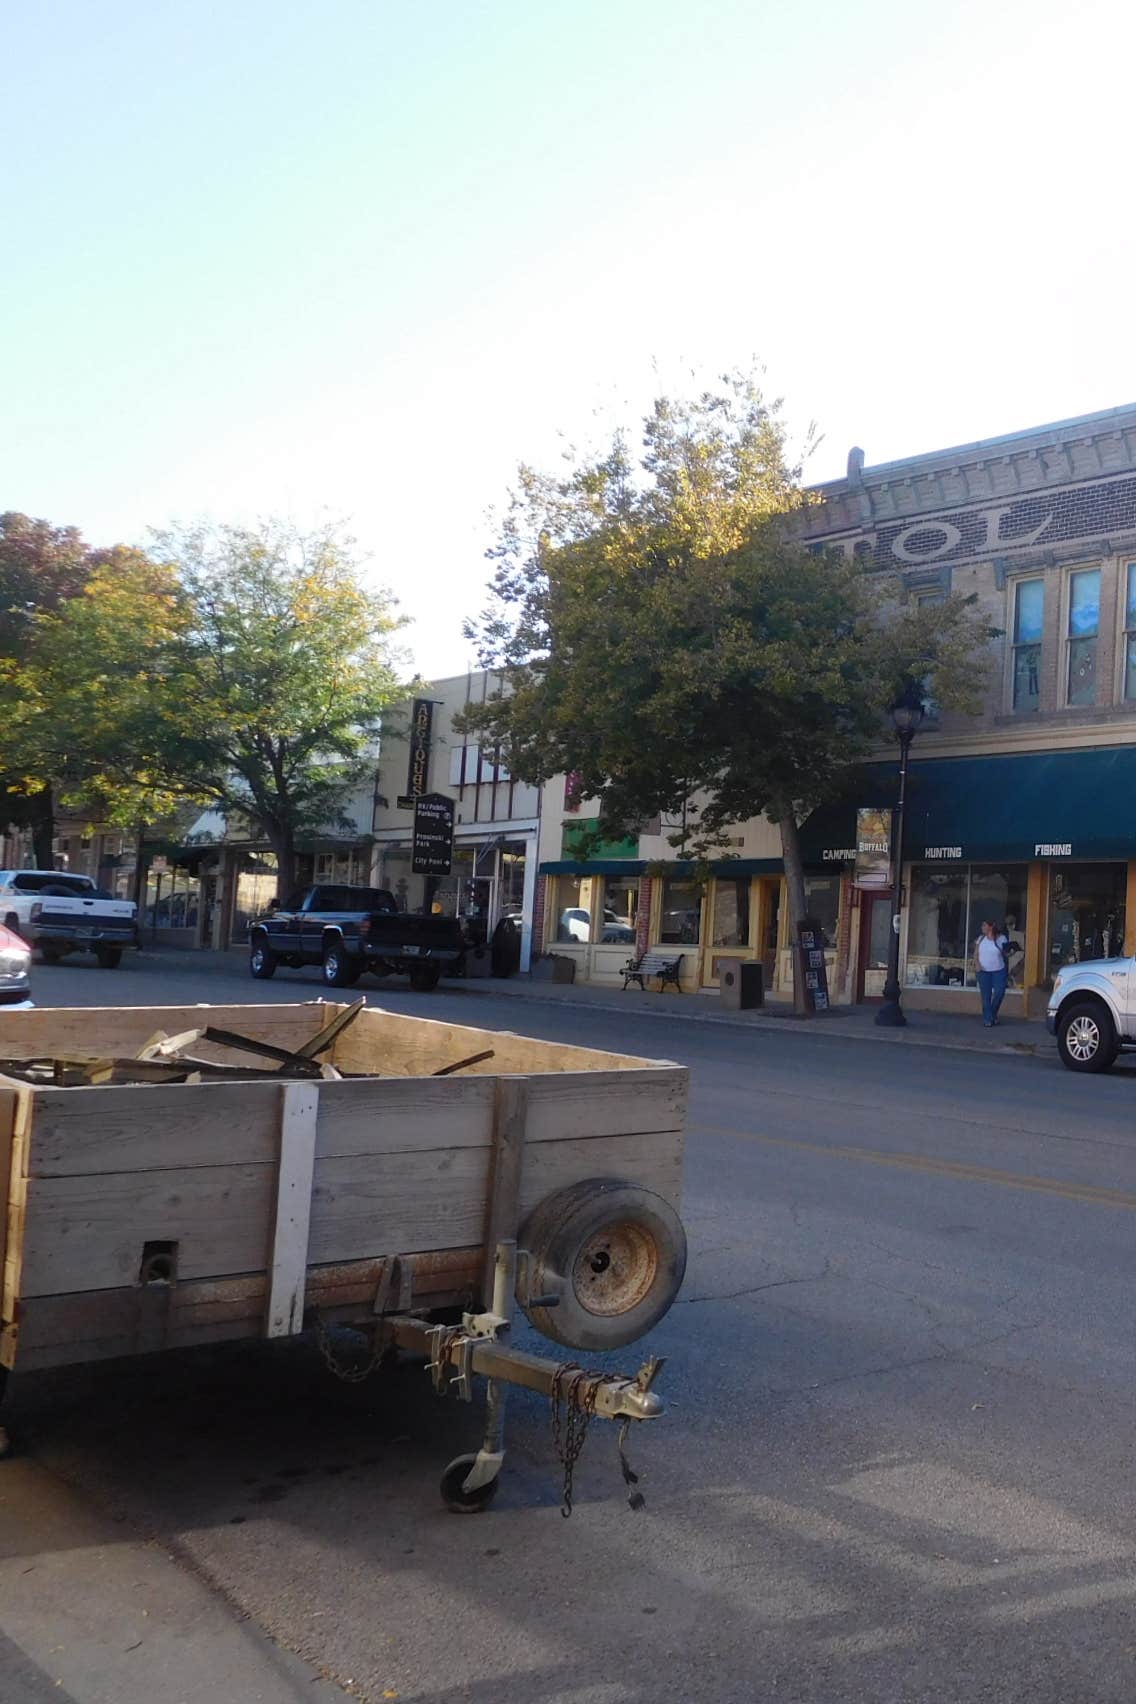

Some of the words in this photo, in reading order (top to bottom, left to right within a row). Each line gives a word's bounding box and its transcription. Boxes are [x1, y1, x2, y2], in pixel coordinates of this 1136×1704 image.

[417, 810, 440, 819] Parking
[858, 841, 889, 853] BUFFALO
[925, 847, 962, 859] HUNTING
[1034, 843, 1072, 856] FISHING
[415, 857, 428, 865] City
